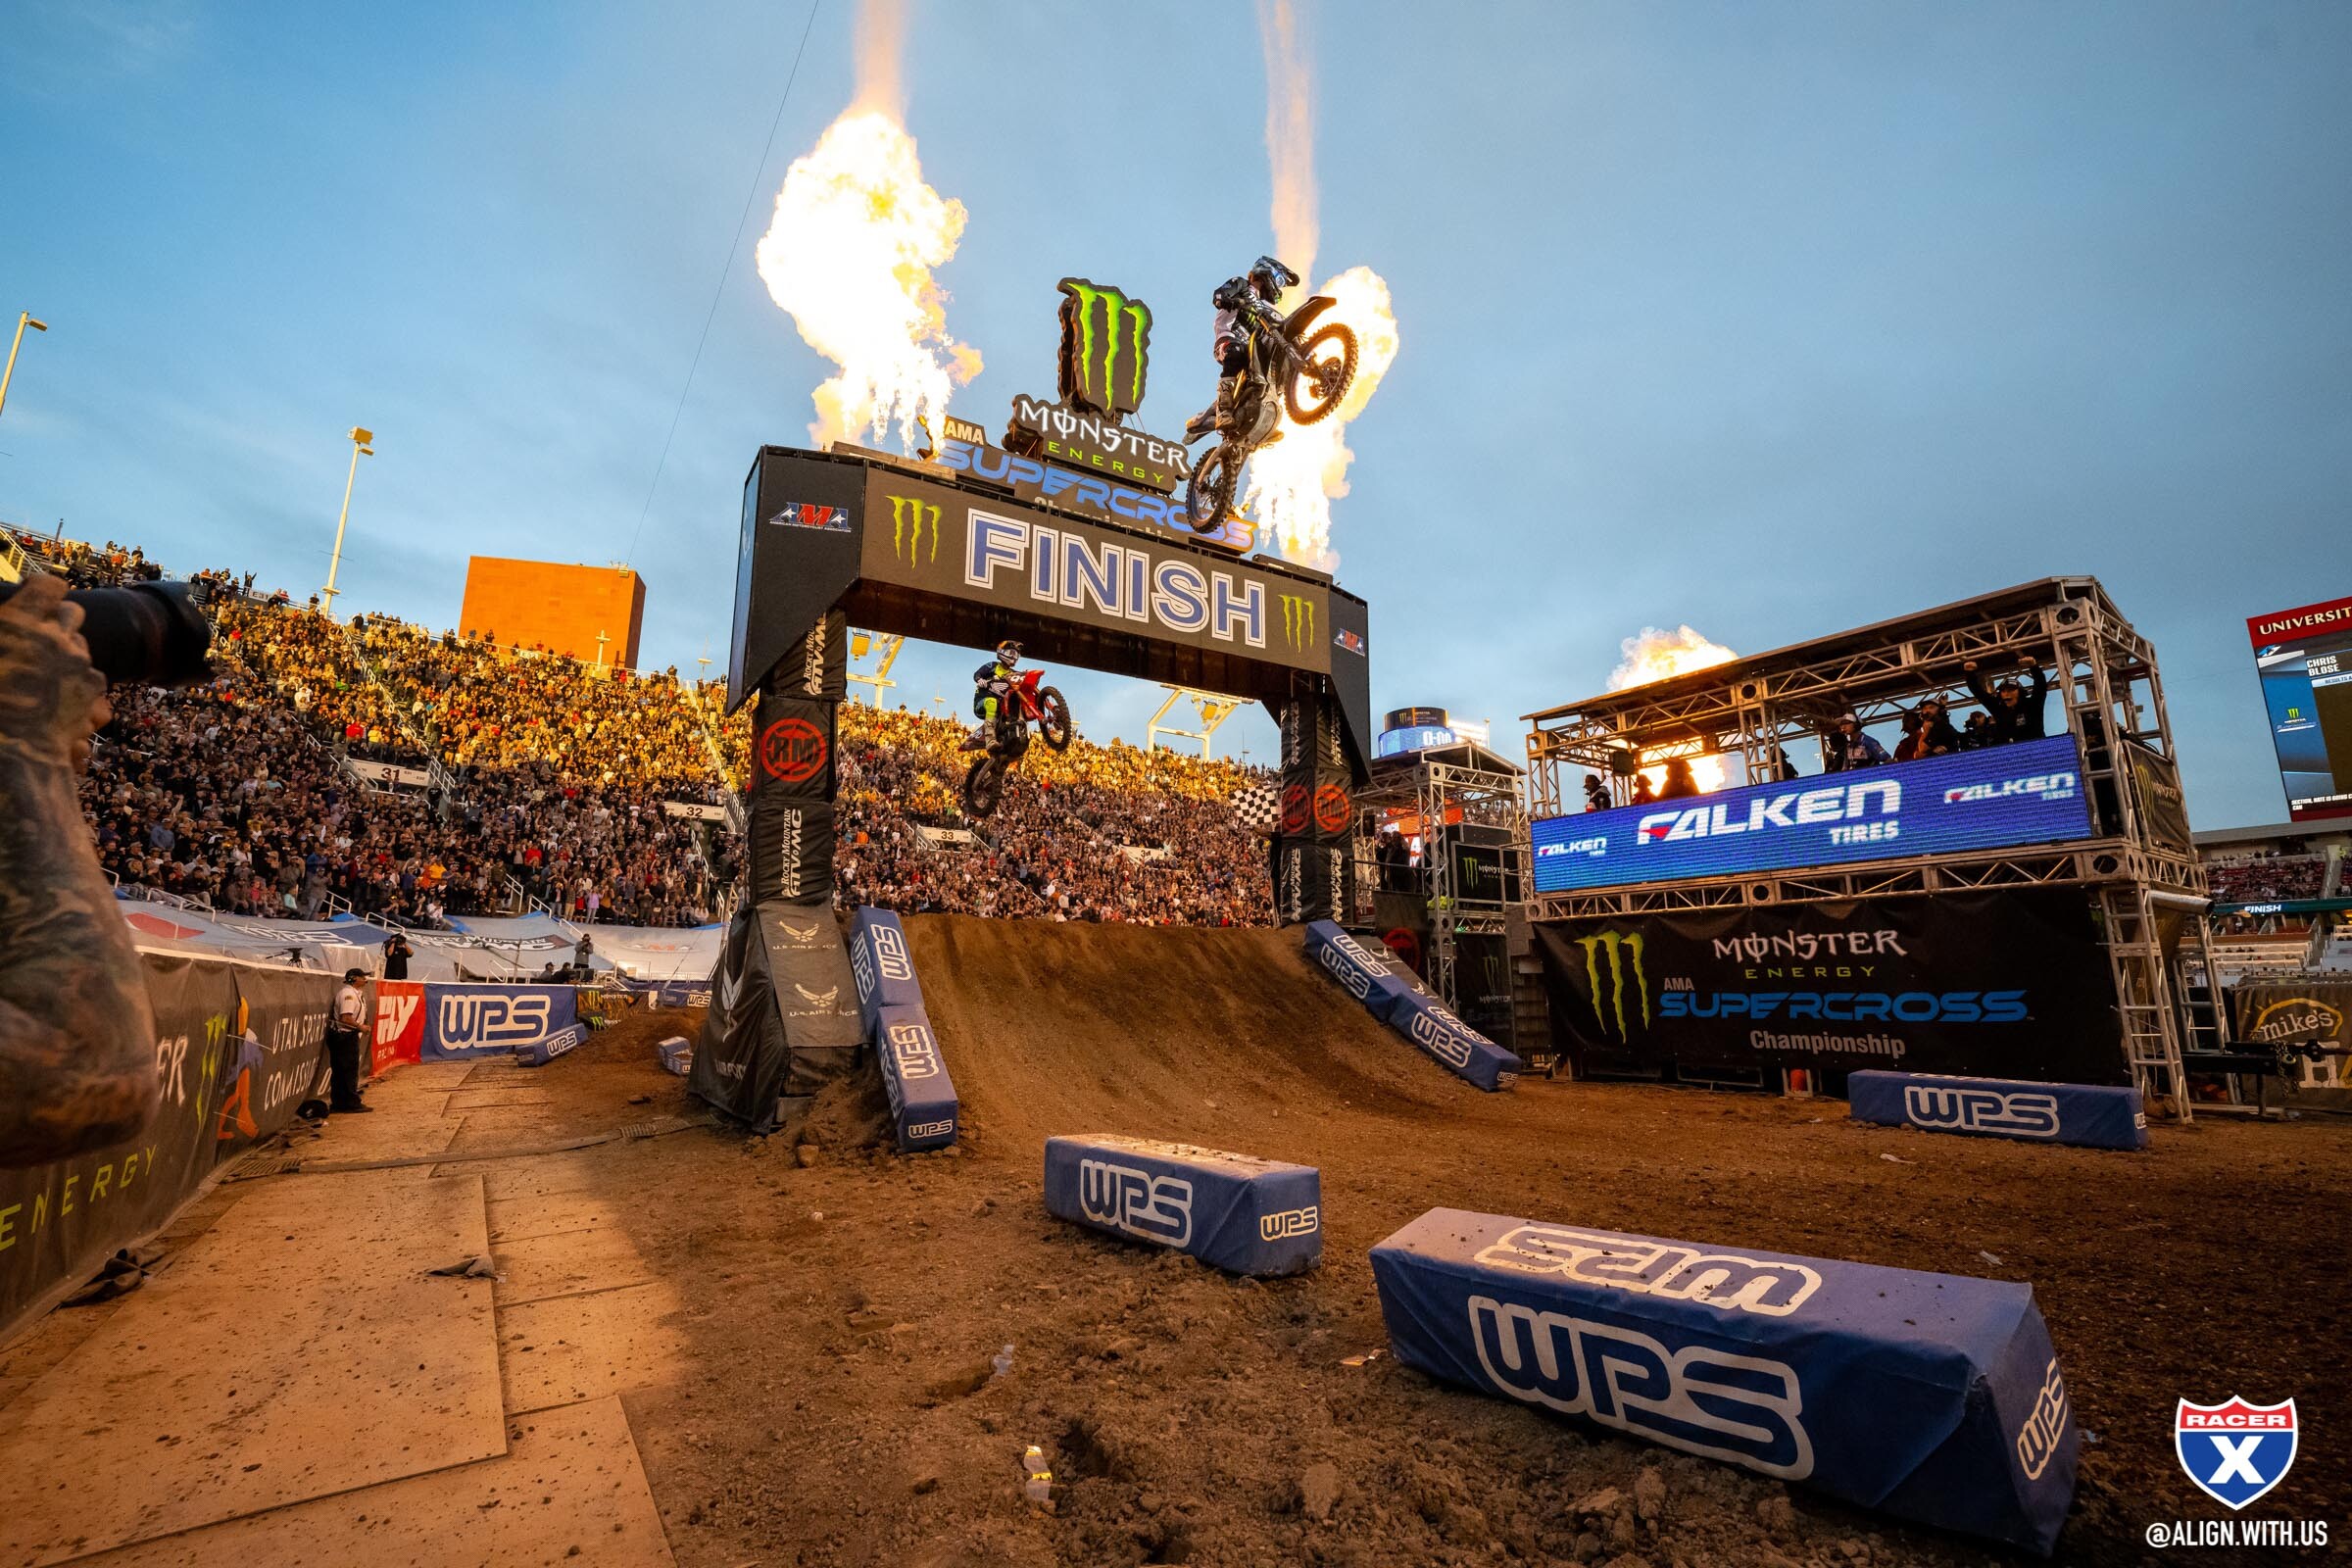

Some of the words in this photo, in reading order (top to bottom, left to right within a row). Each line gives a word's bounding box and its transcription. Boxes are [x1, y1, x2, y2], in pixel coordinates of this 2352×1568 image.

[945, 420, 984, 445] AMA
[1019, 400, 1191, 474] MONSTER
[1048, 441, 1165, 483] ENERGY
[768, 502, 851, 526] AMA
[965, 508, 1266, 649] FINISH
[2306, 656, 2337, 667] CHRIS
[2308, 663, 2341, 676] BLOSE
[381, 767, 400, 780] 31
[1943, 772, 2076, 804] FALKEN
[686, 807, 704, 817] 32
[1637, 778, 1902, 845] FALKEN
[782, 808, 791, 856] MOUNTAIN
[941, 830, 954, 840] 33
[1538, 837, 1607, 857] FALKEN
[1829, 820, 1900, 845] TIRES
[781, 856, 790, 886] ROCKY
[2244, 904, 2281, 913] FINISH
[871, 923, 911, 981] WPS
[1333, 934, 1392, 977] WPS
[1714, 928, 1908, 963] MONSTER
[1321, 943, 1370, 1000] WPS
[1663, 977, 1694, 991] AMA
[1745, 965, 1877, 979] ENERGY
[687, 993, 711, 1007] WPS
[1658, 990, 2029, 1022] SUPERCROSS
[272, 1017, 299, 1054] UTAH
[377, 996, 419, 1046] FLY
[439, 994, 551, 1050] WPS
[2260, 1010, 2334, 1042] mike's
[546, 1030, 577, 1056] WPS
[1411, 1012, 1472, 1068] WPS
[1749, 1029, 1906, 1058] Championship
[1904, 1086, 2060, 1137] WPS
[908, 1119, 953, 1138] WPS
[0, 1144, 157, 1251] ENERGY
[1080, 1158, 1193, 1248] WPS
[1260, 1205, 1318, 1242] WPS
[1473, 1225, 1823, 1317] WPS
[1468, 1295, 1815, 1482] WPS
[2017, 1356, 2067, 1481] WPS
